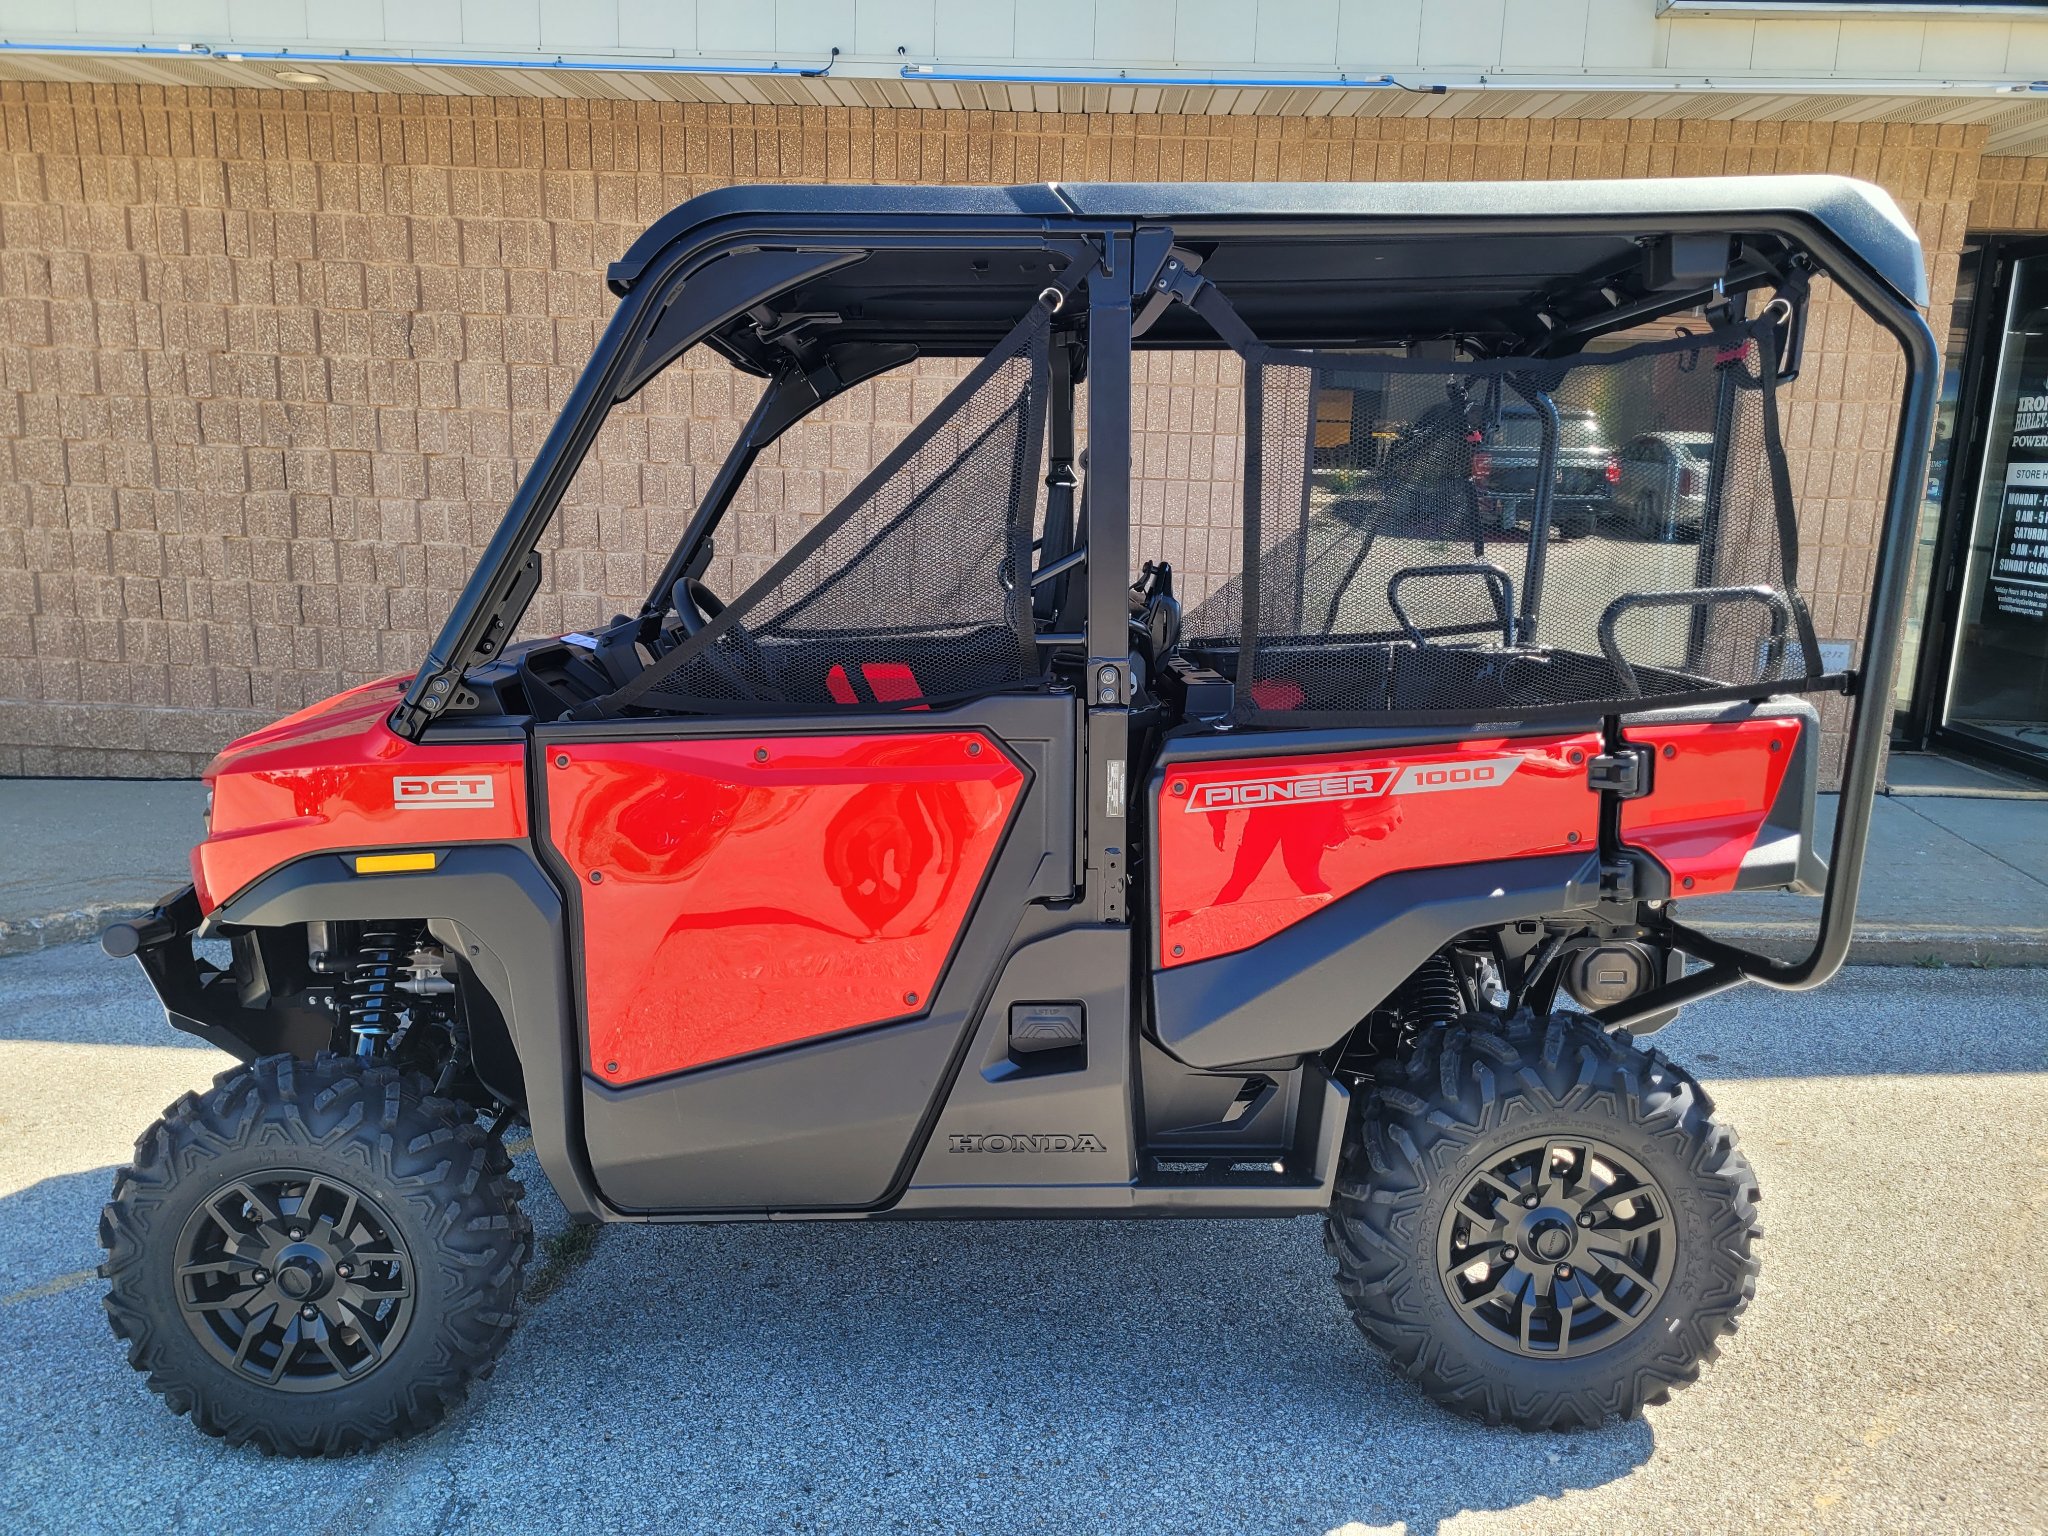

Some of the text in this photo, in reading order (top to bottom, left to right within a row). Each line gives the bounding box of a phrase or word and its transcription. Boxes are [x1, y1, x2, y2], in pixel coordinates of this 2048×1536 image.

[2014, 412, 2048, 432] HARLEY-
[2012, 435, 2048, 447] POWER
[2016, 470, 2048, 479] STORE H
[2008, 493, 2039, 506] MONDAY
[2015, 510, 2021, 521] 9
[2021, 511, 2034, 522] AM
[2039, 512, 2045, 523] 5
[2014, 526, 2048, 541] SATURDA
[2010, 543, 2016, 555] 9
[2016, 544, 2029, 556] AM
[2033, 545, 2039, 557] 4
[1999, 558, 2028, 573] SUNDAY
[400, 780, 487, 795] DCT
[1205, 766, 1495, 806] PIONEER 1000
[948, 1134, 1107, 1153] HONDA
